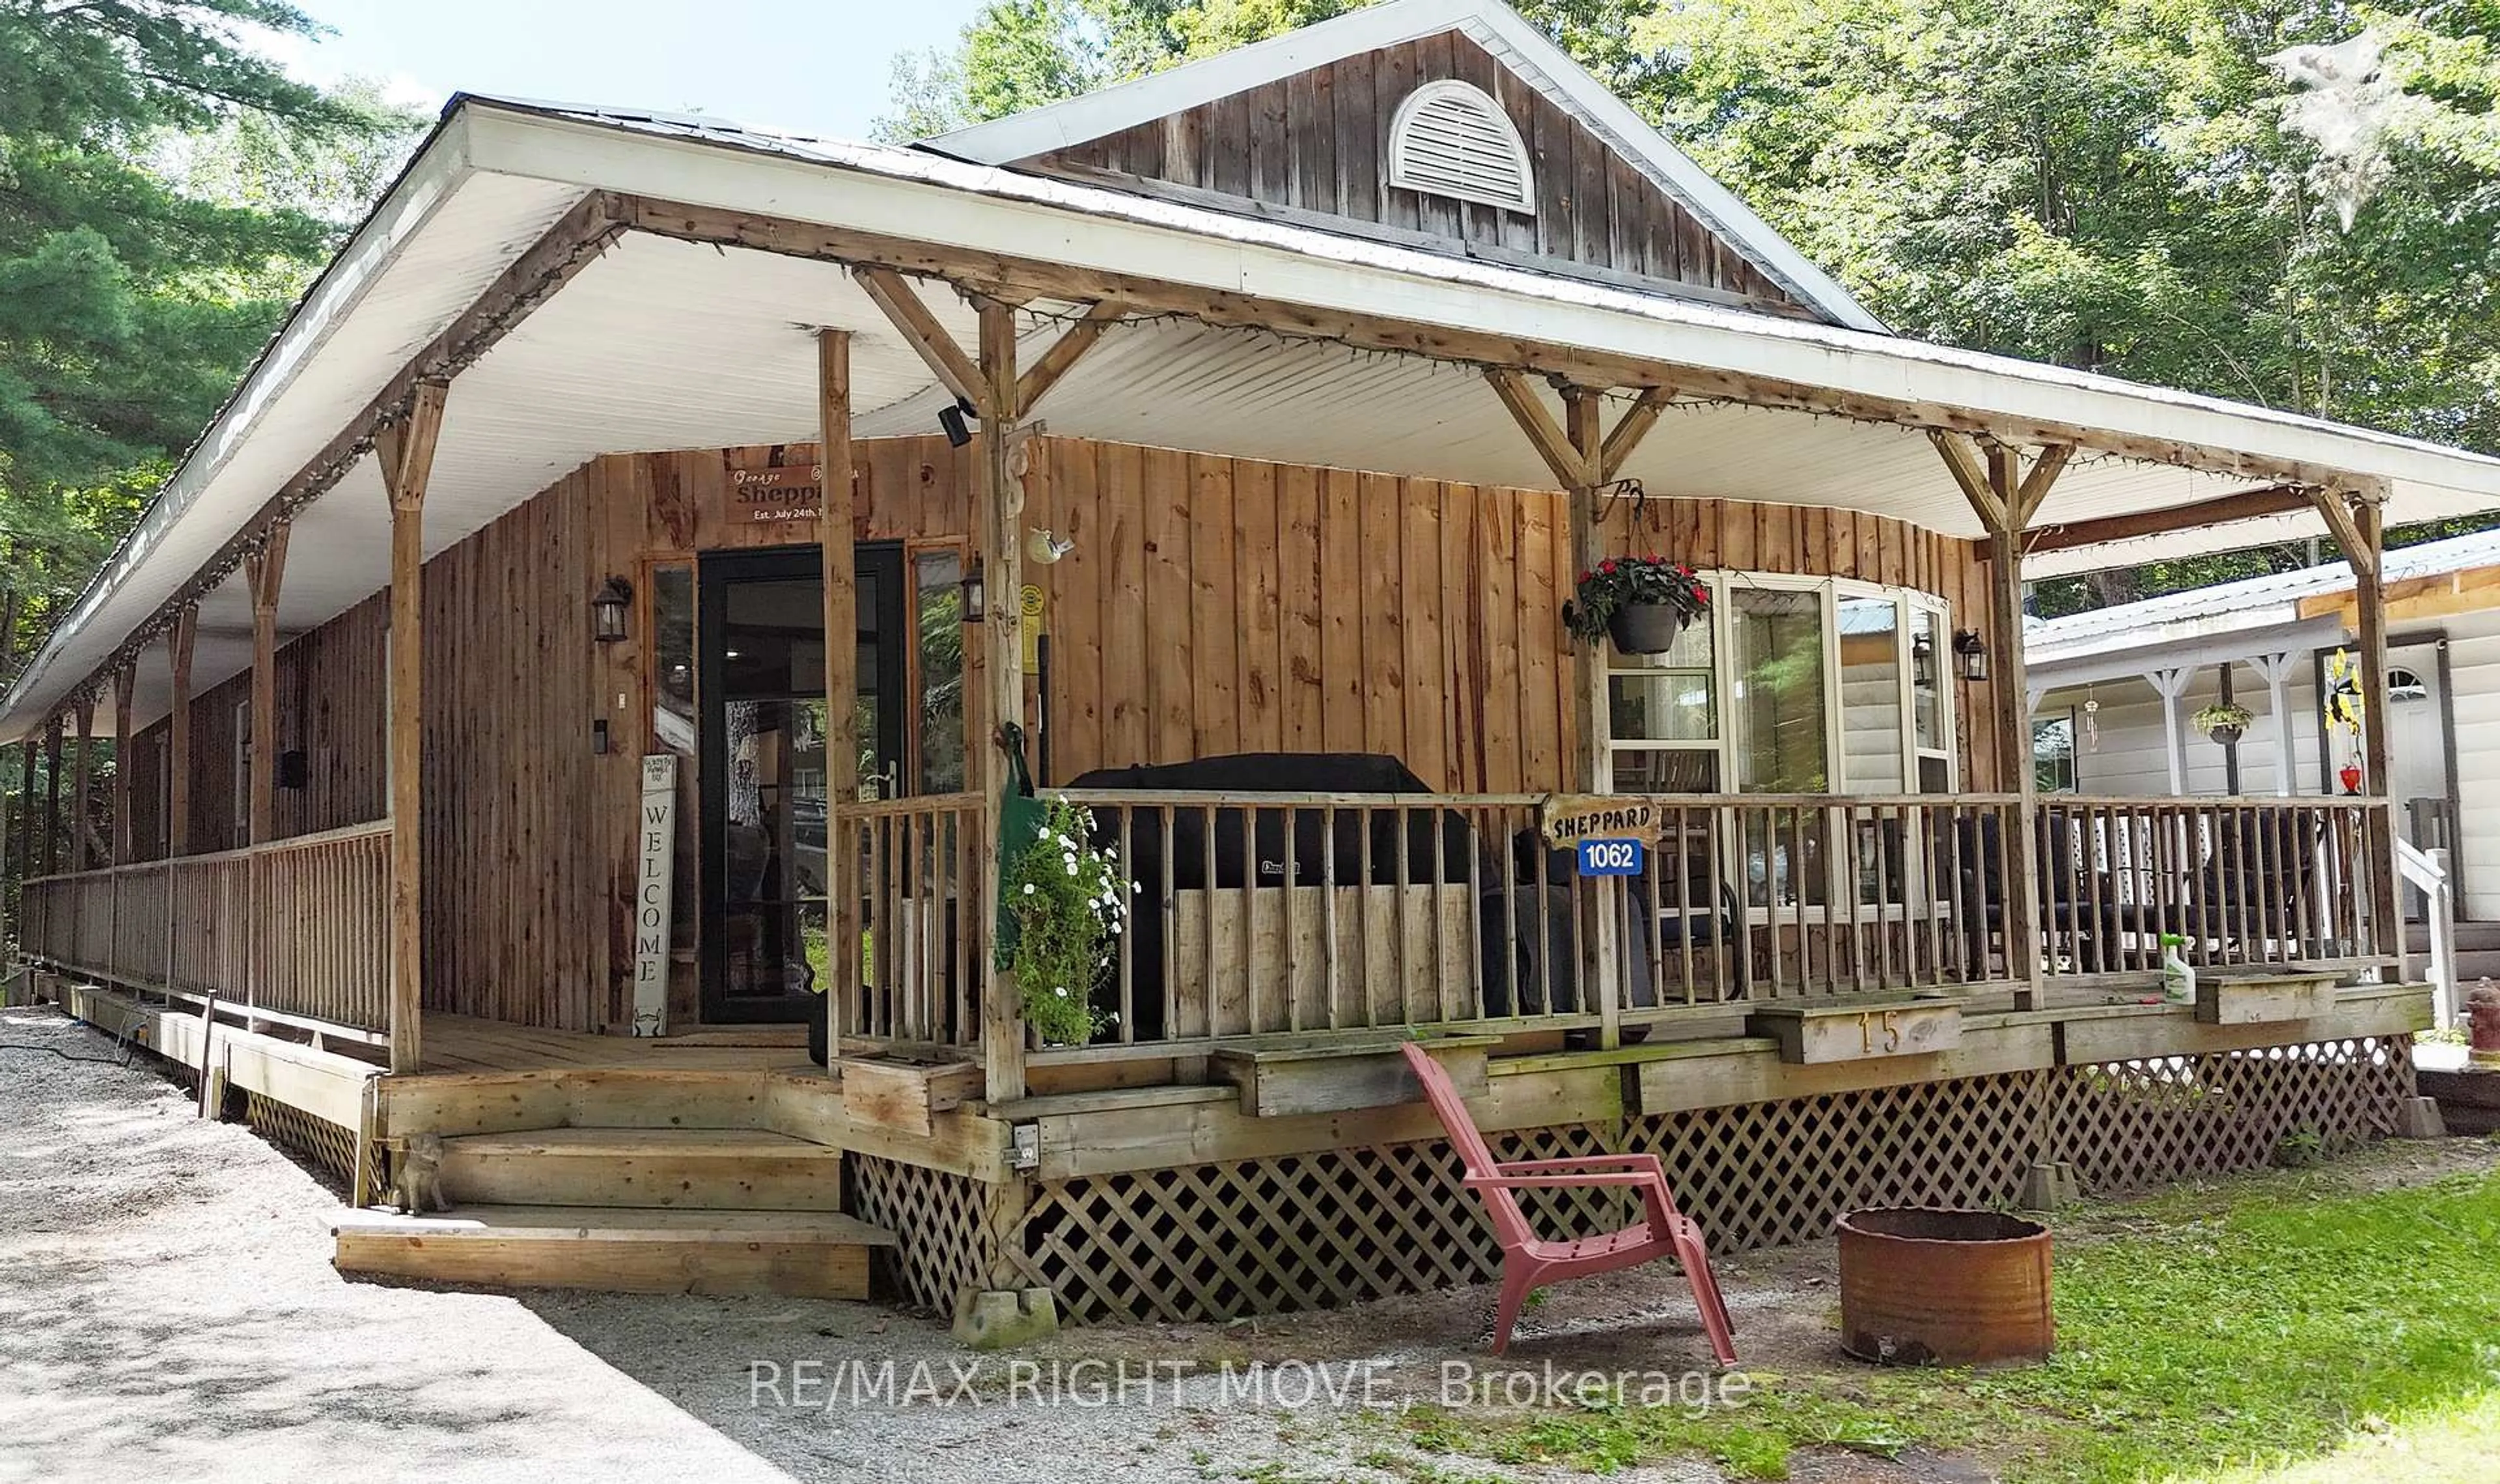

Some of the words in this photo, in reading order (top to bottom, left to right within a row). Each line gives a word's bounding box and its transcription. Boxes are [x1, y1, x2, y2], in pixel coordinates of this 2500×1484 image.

[1554, 807, 1650, 838] SHEPPARD
[1586, 844, 1633, 868] 1062
[639, 806, 668, 981] WELCOME
[1859, 1011, 1898, 1053] 15
